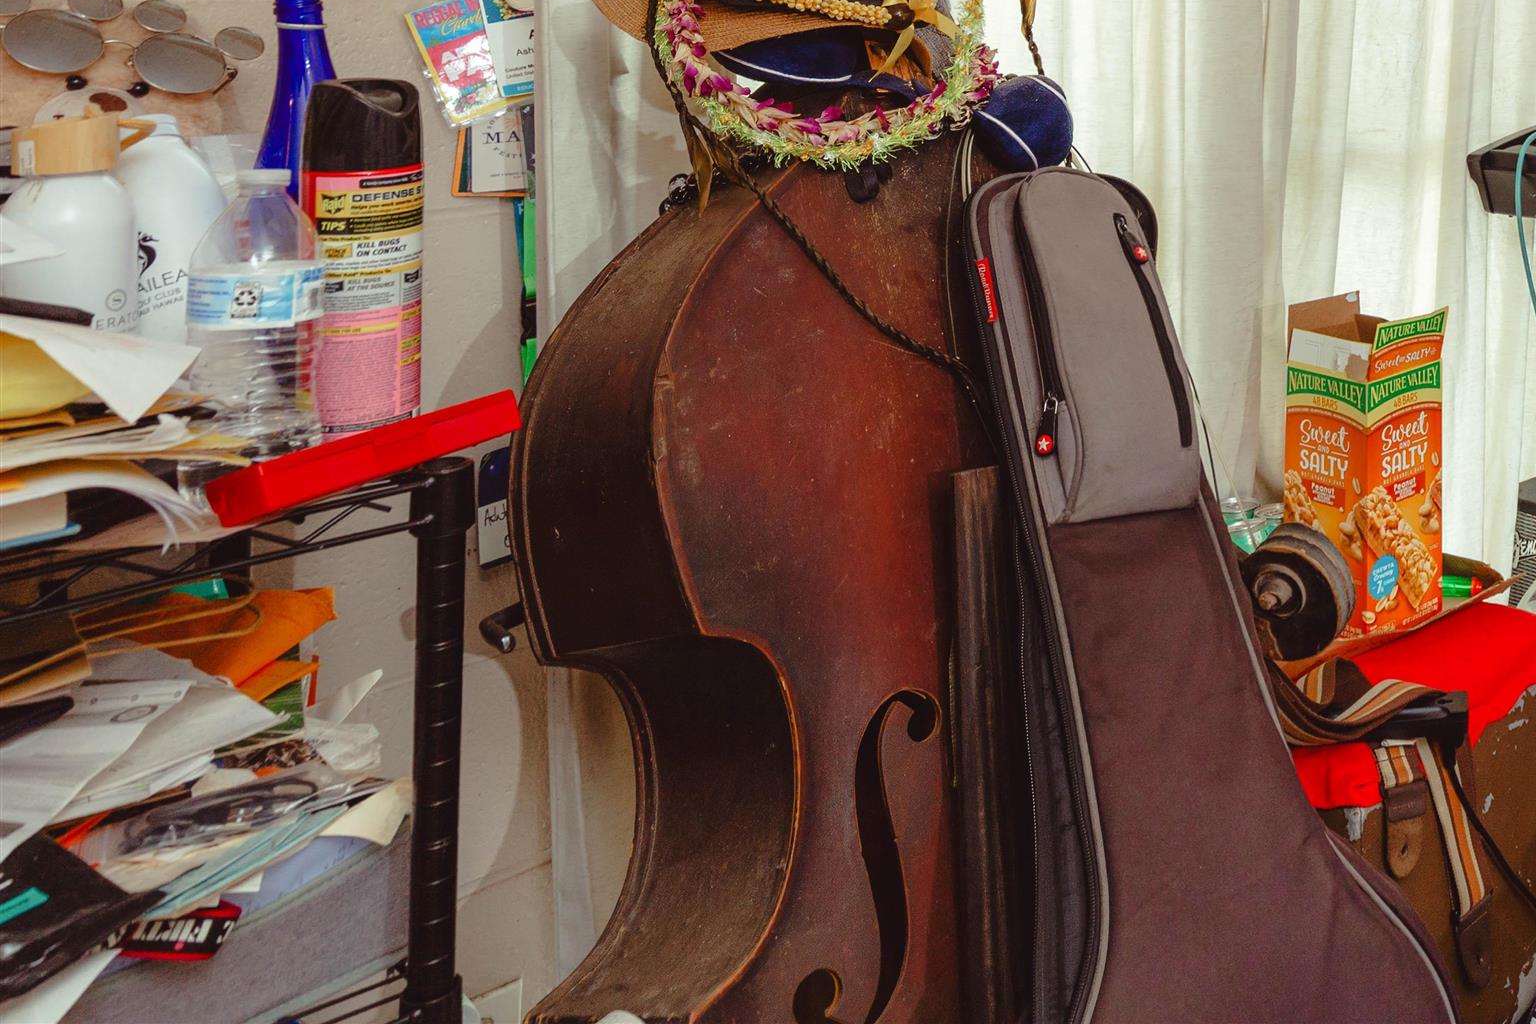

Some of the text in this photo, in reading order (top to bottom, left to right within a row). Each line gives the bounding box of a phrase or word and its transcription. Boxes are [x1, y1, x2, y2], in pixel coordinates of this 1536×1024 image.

[414, 0, 465, 29] REGGAE
[352, 189, 414, 202] DEFENSE
[323, 197, 344, 211] Raid
[321, 222, 346, 231] TIPS
[356, 238, 400, 248] KILL BUGS
[356, 245, 407, 257] ON CONTACT
[155, 287, 181, 300] CLUB
[1379, 314, 1444, 347] NATURE VALLEY
[1375, 347, 1430, 374] Sweet SALTY
[1289, 371, 1365, 409] NATURE VALLEY
[1370, 365, 1438, 407] NATURE VALLEY
[1312, 396, 1338, 410] 48 BARS
[1393, 392, 1418, 408] 48 BARS
[1300, 419, 1350, 453] Sweet
[1381, 411, 1429, 451] Sweet
[1317, 445, 1330, 454] AND
[1399, 440, 1411, 450] AND
[1300, 449, 1348, 480] SALTY
[1381, 442, 1427, 478] SALTY
[1311, 482, 1335, 495] Peanut
[1394, 476, 1416, 492] Peanut
